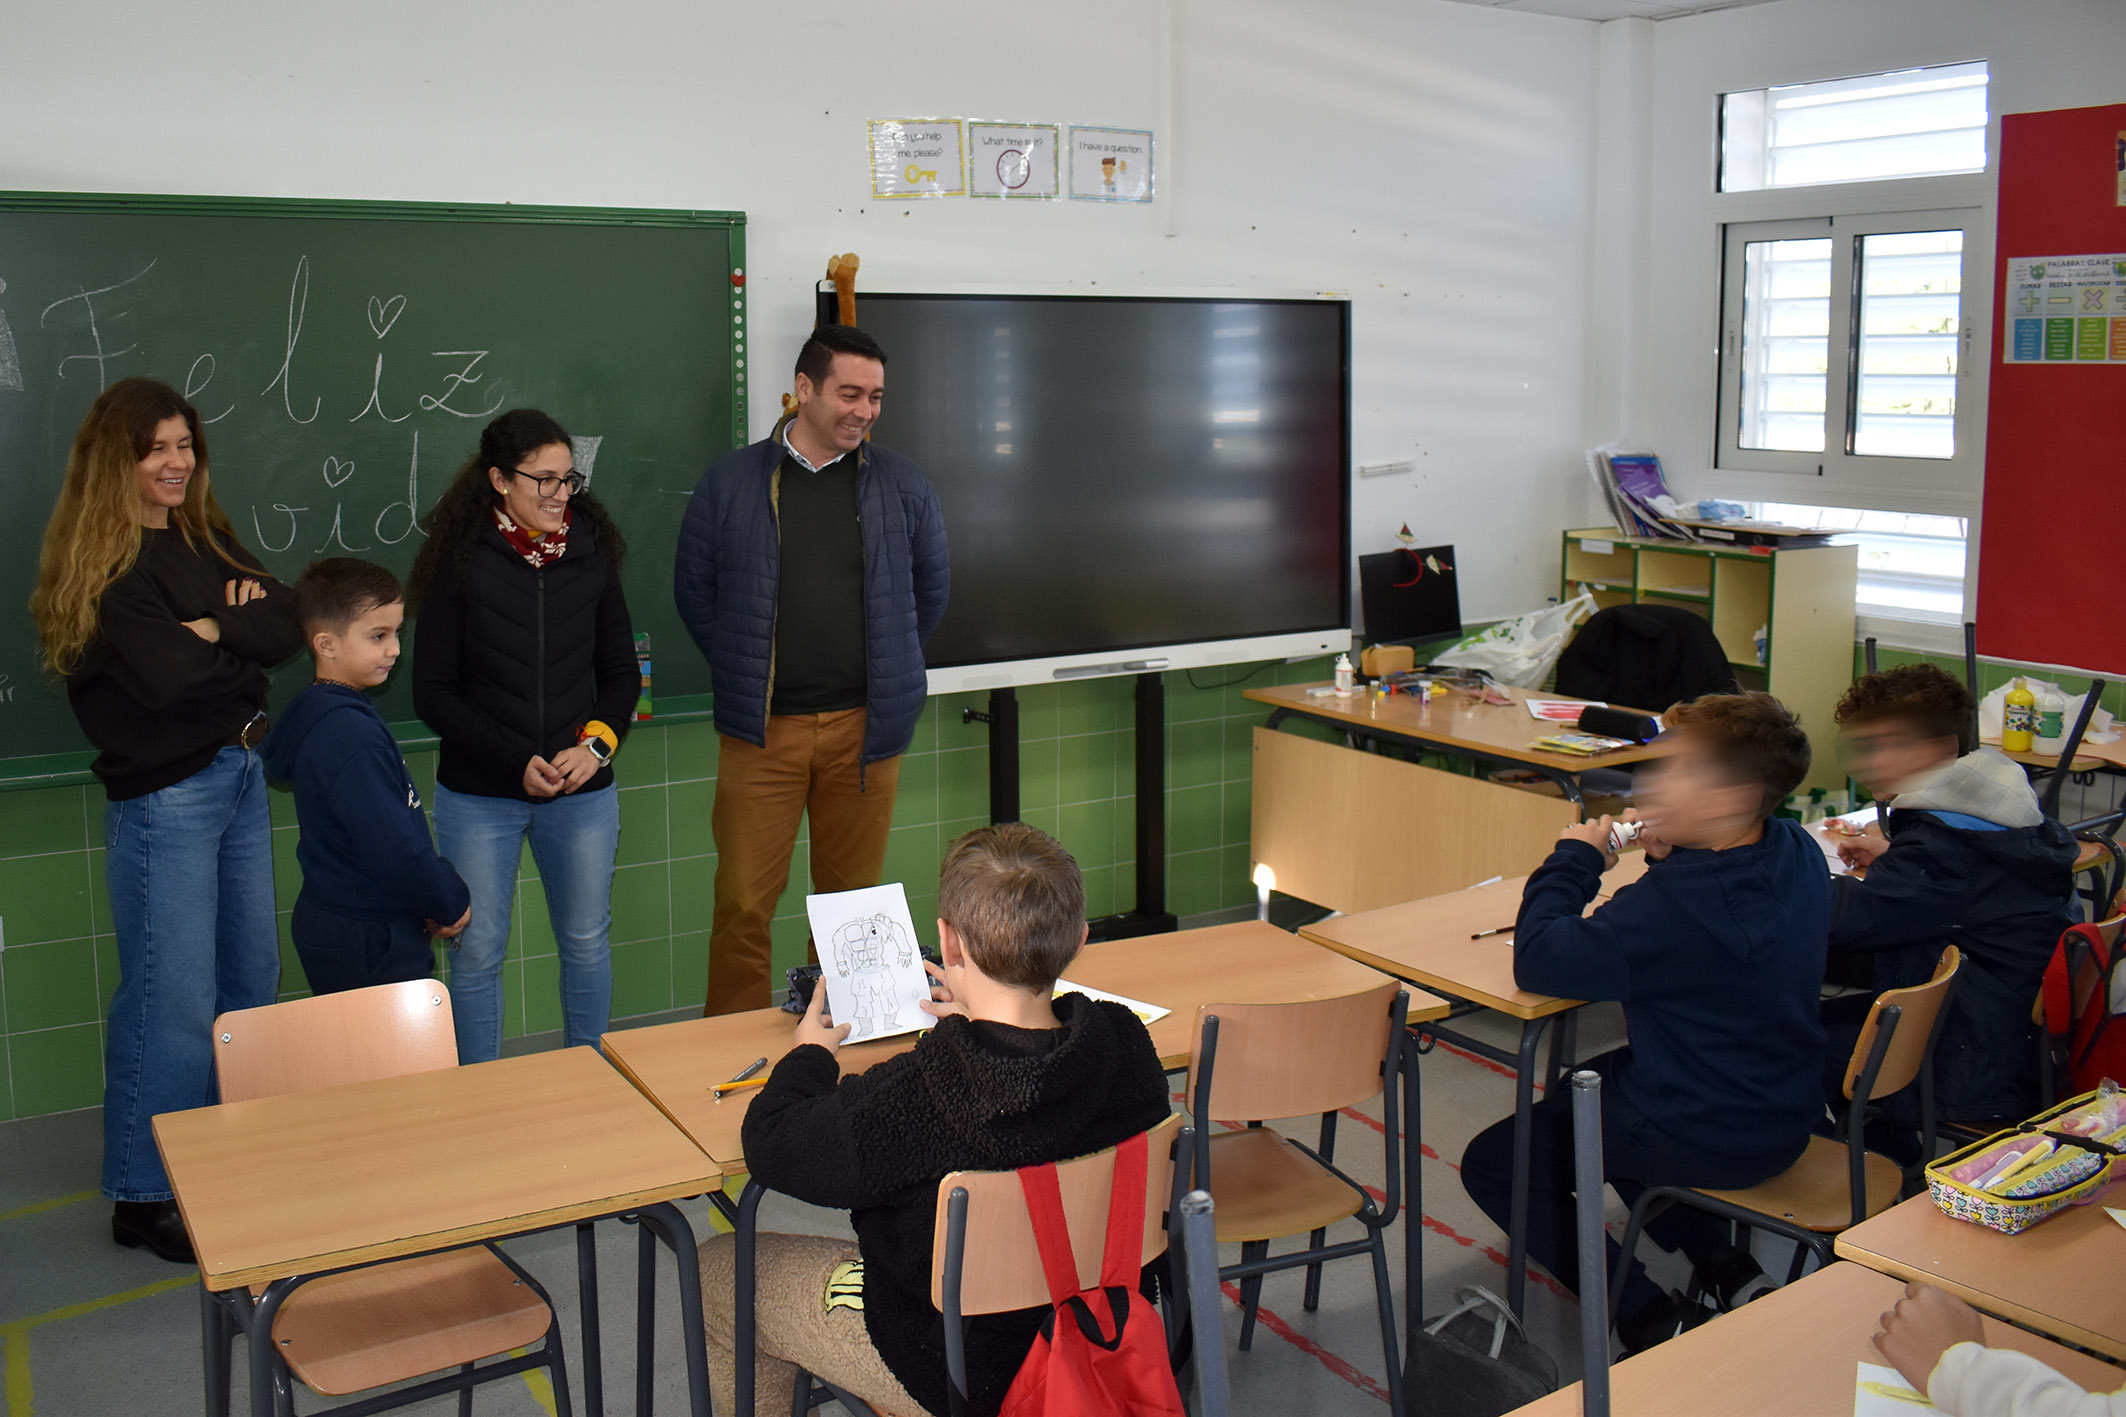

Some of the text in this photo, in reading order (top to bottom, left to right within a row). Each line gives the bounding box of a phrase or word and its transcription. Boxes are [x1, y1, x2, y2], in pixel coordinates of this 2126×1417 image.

[925, 131, 942, 141] help
[982, 136, 1004, 146] What
[1006, 136, 1023, 147] time
[1033, 137, 1044, 147] it?
[913, 147, 944, 160] please?
[1083, 141, 1103, 151] have
[1110, 143, 1144, 155] question.
[2087, 258, 2111, 266] CLAVE
[41, 254, 506, 424] Feliz
